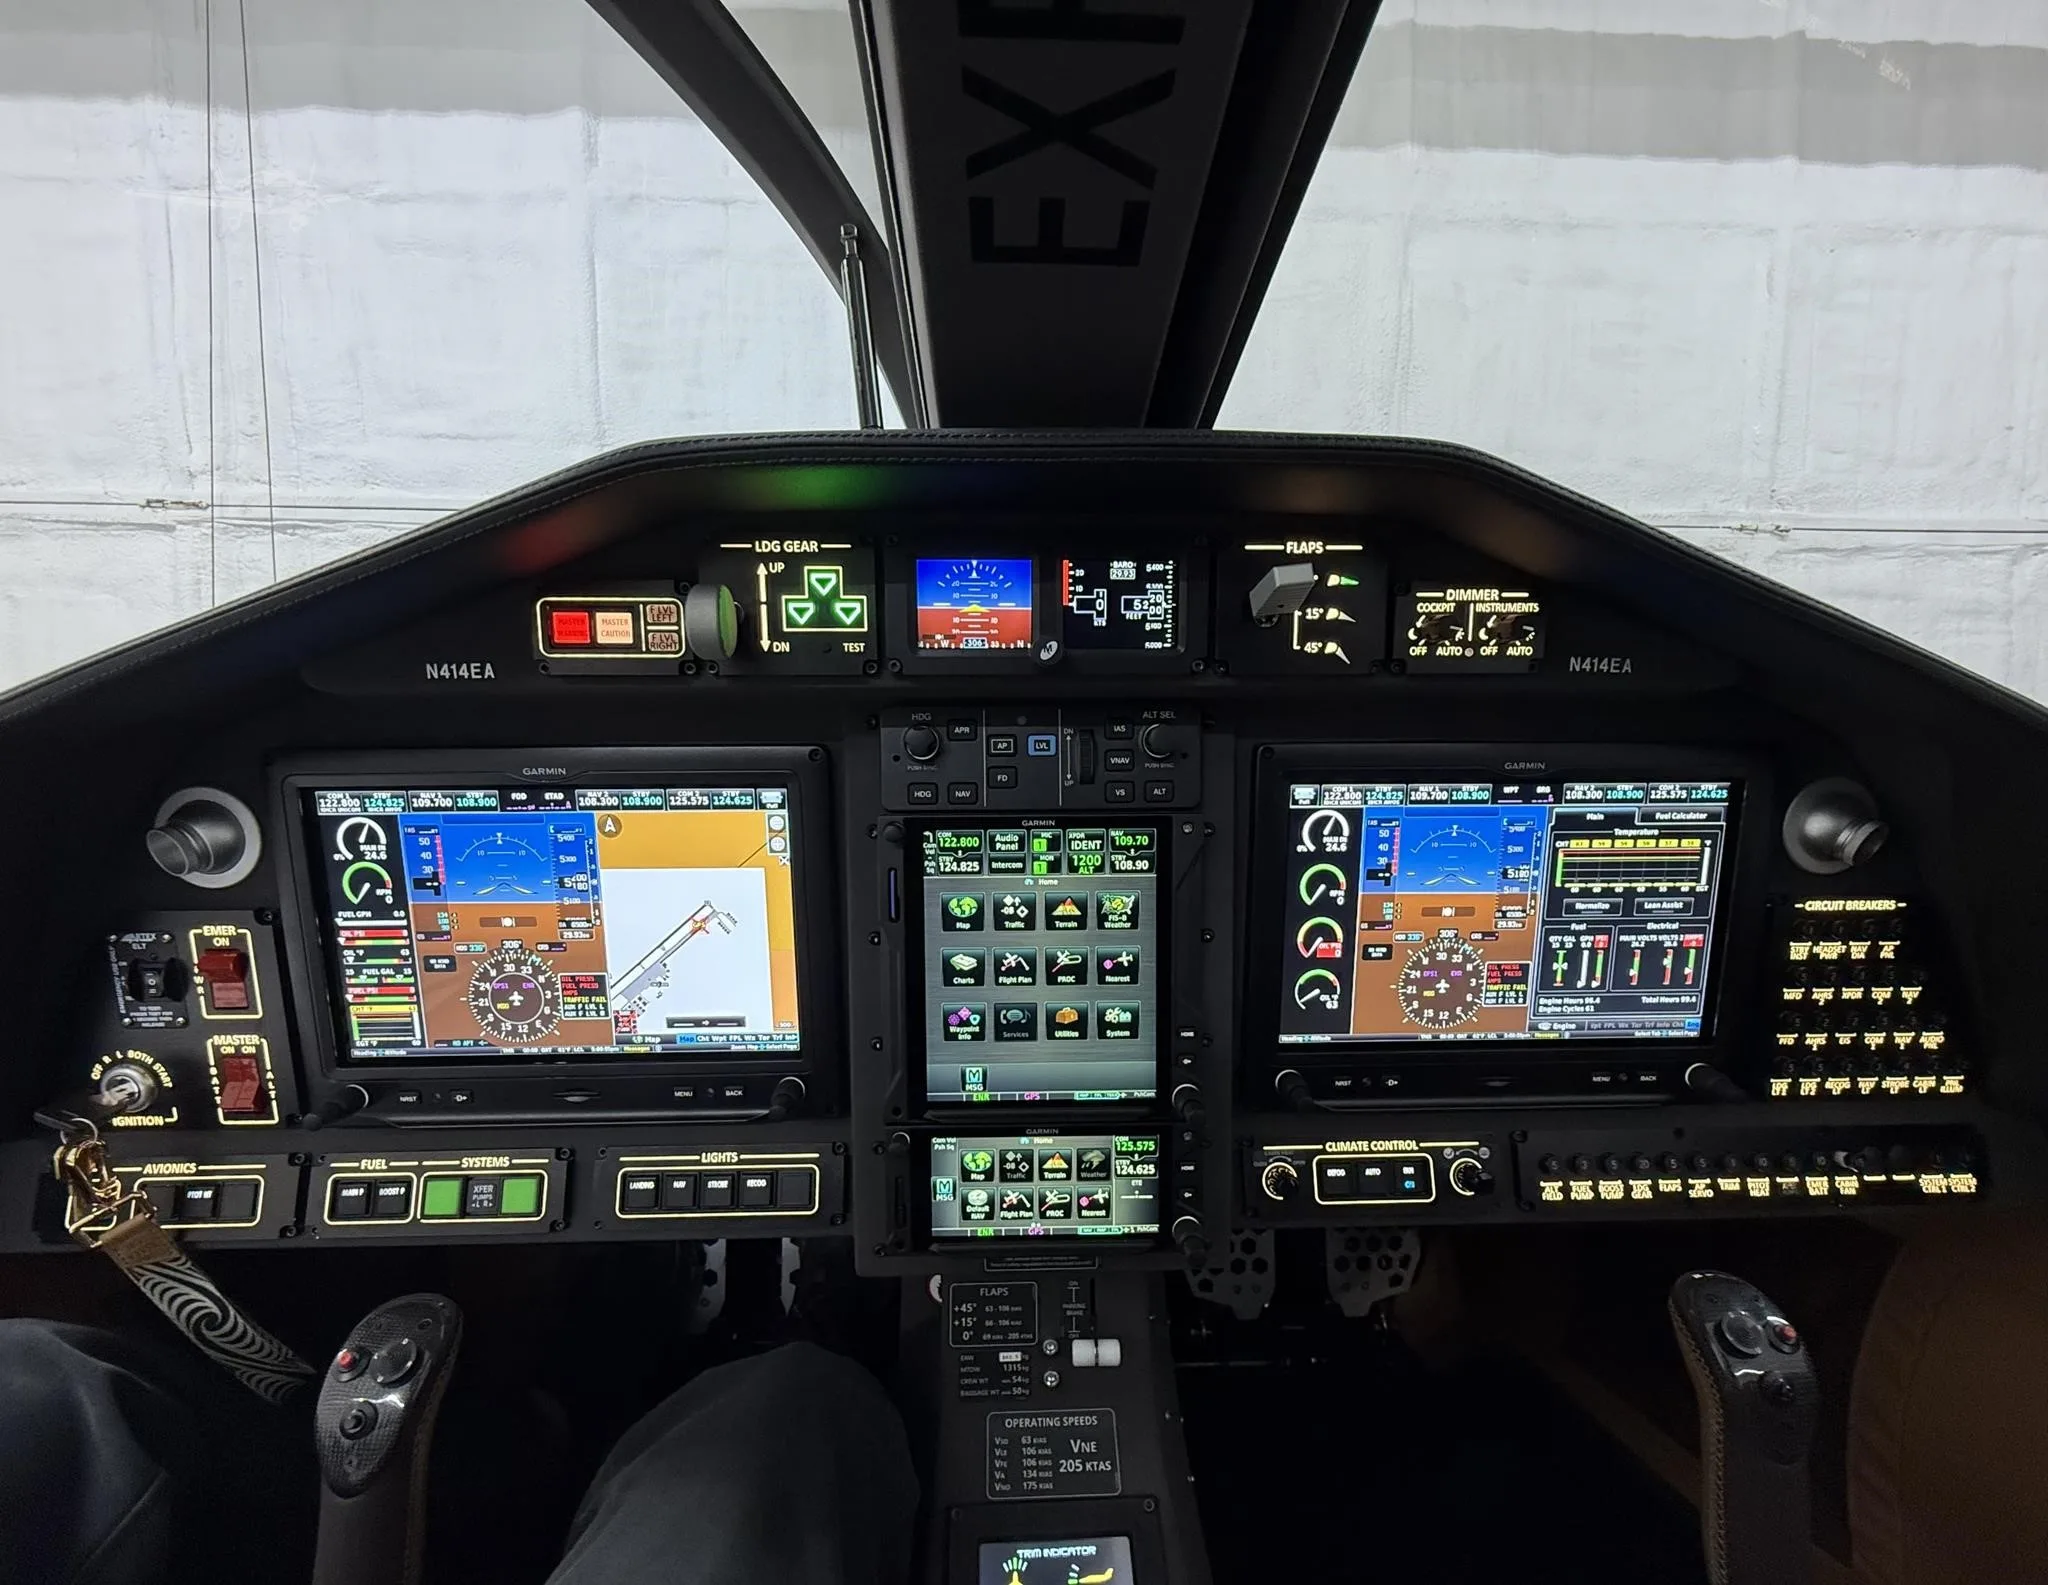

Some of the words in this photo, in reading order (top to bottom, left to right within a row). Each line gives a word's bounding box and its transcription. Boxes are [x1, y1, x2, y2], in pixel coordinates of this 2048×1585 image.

[755, 541, 781, 552] LDG
[784, 541, 818, 552] GEAR
[1286, 542, 1324, 554] FLAPS
[769, 562, 785, 572] UP
[1446, 588, 1499, 601] DIMMER
[658, 606, 673, 614] LVL
[1416, 603, 1455, 613] COCKPIT
[1476, 603, 1539, 613] INSTRUMENTS
[652, 613, 672, 622] LEFT
[1305, 608, 1324, 620] 15°
[651, 641, 677, 650] RIGHT
[773, 642, 789, 652] DN
[843, 643, 865, 652] TEST
[968, 639, 982, 647] 306
[1304, 642, 1323, 654] 45°
[1409, 646, 1427, 656] OFF
[1436, 646, 1463, 656] AUTO
[1480, 646, 1498, 656] OFF
[1506, 646, 1533, 656] AUTO
[1569, 657, 1632, 674] N414EA
[425, 663, 495, 679] N414EA
[911, 713, 932, 721] HDG
[1143, 711, 1158, 719] ALT
[1160, 711, 1176, 719] SEL
[1036, 741, 1048, 749] LVL
[1504, 762, 1545, 770] GARMIN
[522, 767, 566, 775] GARMIN
[997, 774, 1008, 782] FD
[914, 790, 932, 798] HDG
[955, 790, 970, 798] NAV
[1324, 792, 1362, 800] 122.800
[1365, 792, 1403, 800] 124.825
[1410, 791, 1448, 800] 109.700
[1451, 791, 1489, 800] 108.900
[1565, 791, 1603, 800] 108.300
[1606, 790, 1644, 799] 108.900
[1650, 790, 1688, 799] 125.575
[1690, 790, 1728, 799] 124.625
[319, 798, 360, 807] 122.800
[364, 798, 405, 807] 124.825
[412, 797, 452, 807] 109.700
[456, 797, 497, 806] 108.900
[579, 797, 618, 806] 108.300
[622, 797, 662, 806] 108.900
[669, 796, 709, 805] 125.575
[713, 796, 752, 805] 124.625
[1656, 812, 1671, 820] Fuel
[1672, 812, 1708, 820] Calculator
[1614, 828, 1659, 837] Temperature
[939, 837, 979, 847] 122.800
[995, 834, 1019, 842] Audio
[1115, 836, 1149, 845] 109.70
[996, 842, 1018, 850] Panel
[1071, 840, 1102, 850] IDENT
[1326, 843, 1347, 851] 24.6
[364, 852, 387, 860] 24.6
[1073, 855, 1101, 866] 1200
[939, 862, 980, 872] 124.825
[1078, 866, 1094, 874] ALT
[1115, 861, 1149, 870] 108.90
[1576, 902, 1610, 910] Normalize
[1663, 901, 1684, 909] Assist
[1804, 900, 1845, 911] CIRCUIT
[1846, 900, 1896, 910] BREAKERS
[956, 922, 970, 930] Map
[1647, 922, 1679, 930] Electrical
[203, 926, 236, 936] EMER
[213, 937, 230, 946] ON
[1813, 945, 1847, 954] HEADSET
[999, 976, 1015, 984] Flight
[1784, 992, 1803, 1000] MFD
[1902, 991, 1919, 999] NAV
[1539, 998, 1562, 1006] Engine
[1563, 997, 1583, 1005] Hours
[1642, 996, 1659, 1004] Total
[1661, 996, 1680, 1004] Hours
[1538, 1005, 1561, 1014] Engine
[1562, 1005, 1584, 1013] Cycles
[1553, 1022, 1576, 1031] Engine
[213, 1035, 260, 1045] MASTER
[1920, 1035, 1945, 1043] AUDIO
[221, 1046, 235, 1054] ON
[241, 1046, 256, 1054] ON
[127, 1050, 154, 1065] BOTH
[91, 1063, 104, 1080] OFF
[153, 1063, 173, 1089] START
[265, 1071, 276, 1098] ALT
[966, 1083, 984, 1091] MSG
[1882, 1080, 1909, 1088] STROBE
[1913, 1080, 1936, 1088] CABIN
[112, 1116, 163, 1127] IGNITION
[1116, 1141, 1155, 1151] 125.575
[1325, 1141, 1369, 1152] CLIMATE
[1370, 1139, 1419, 1151] CONTROL
[701, 1152, 738, 1163] LIGHTS
[361, 1159, 388, 1170] FUEL
[461, 1157, 510, 1168] SYSTEMS
[143, 1163, 197, 1174] AVIONICS
[1115, 1165, 1155, 1175] 124.625
[1365, 1168, 1380, 1176] AUTO
[1006, 1172, 1026, 1180] Traffic
[747, 1179, 766, 1187] RECOG
[473, 1185, 493, 1193] XFER
[1571, 1192, 1594, 1200] PUMP
[1601, 1191, 1624, 1199] PUMP
[1631, 1191, 1652, 1199] GEAR
[980, 1288, 1008, 1296] FLAPS
[954, 1303, 977, 1312] +45°
[1005, 1418, 1061, 1428] OPERATING
[1063, 1416, 1098, 1426] SPEEDS
[1021, 1436, 1031, 1444] 63
[1022, 1447, 1036, 1455] 106
[1059, 1459, 1083, 1472] 205
[1086, 1461, 1112, 1471] KTAS
[1022, 1470, 1037, 1478] 134
[1023, 1481, 1038, 1489] 175
[1016, 1548, 1042, 1559] TRIM
[1043, 1545, 1096, 1557] INDICATOR
